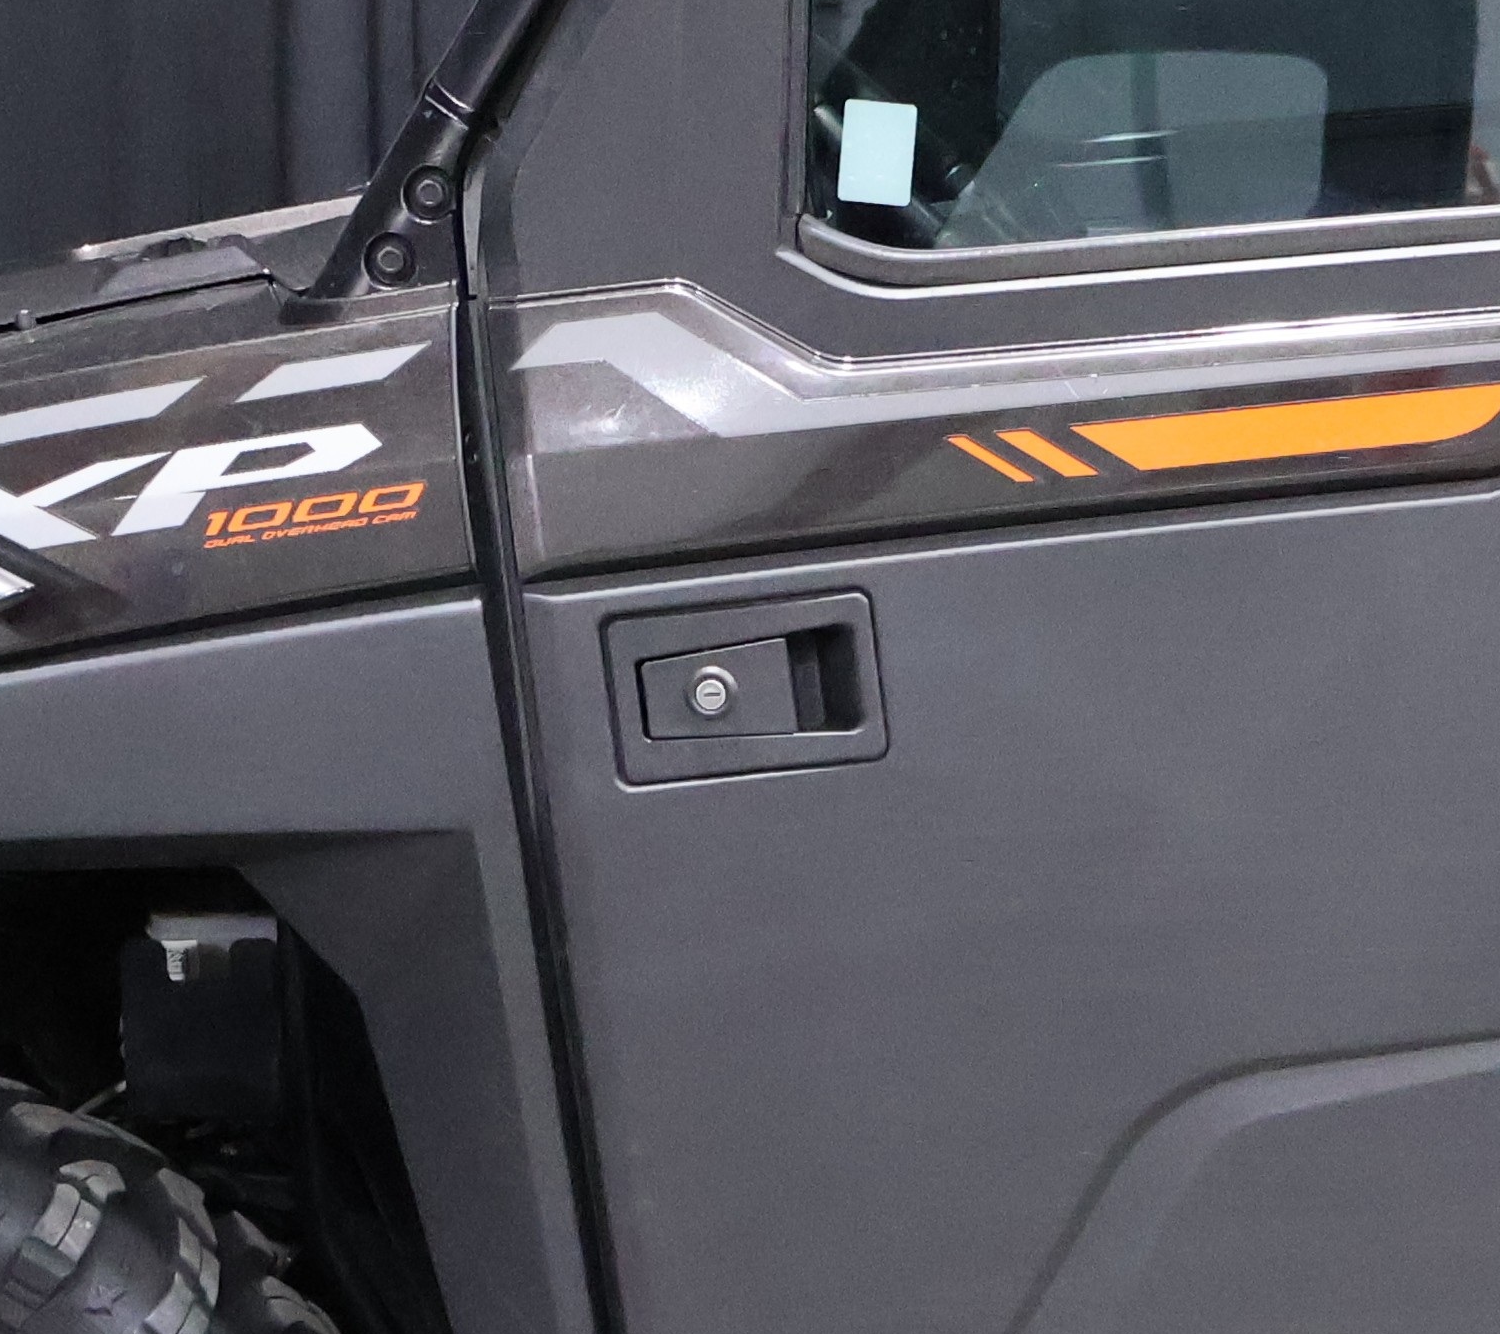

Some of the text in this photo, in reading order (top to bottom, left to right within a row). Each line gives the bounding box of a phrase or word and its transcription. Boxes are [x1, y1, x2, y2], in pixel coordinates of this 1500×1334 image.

[203, 481, 426, 537] 1000
[203, 510, 419, 549] DUAL OVERHEAD CAM
